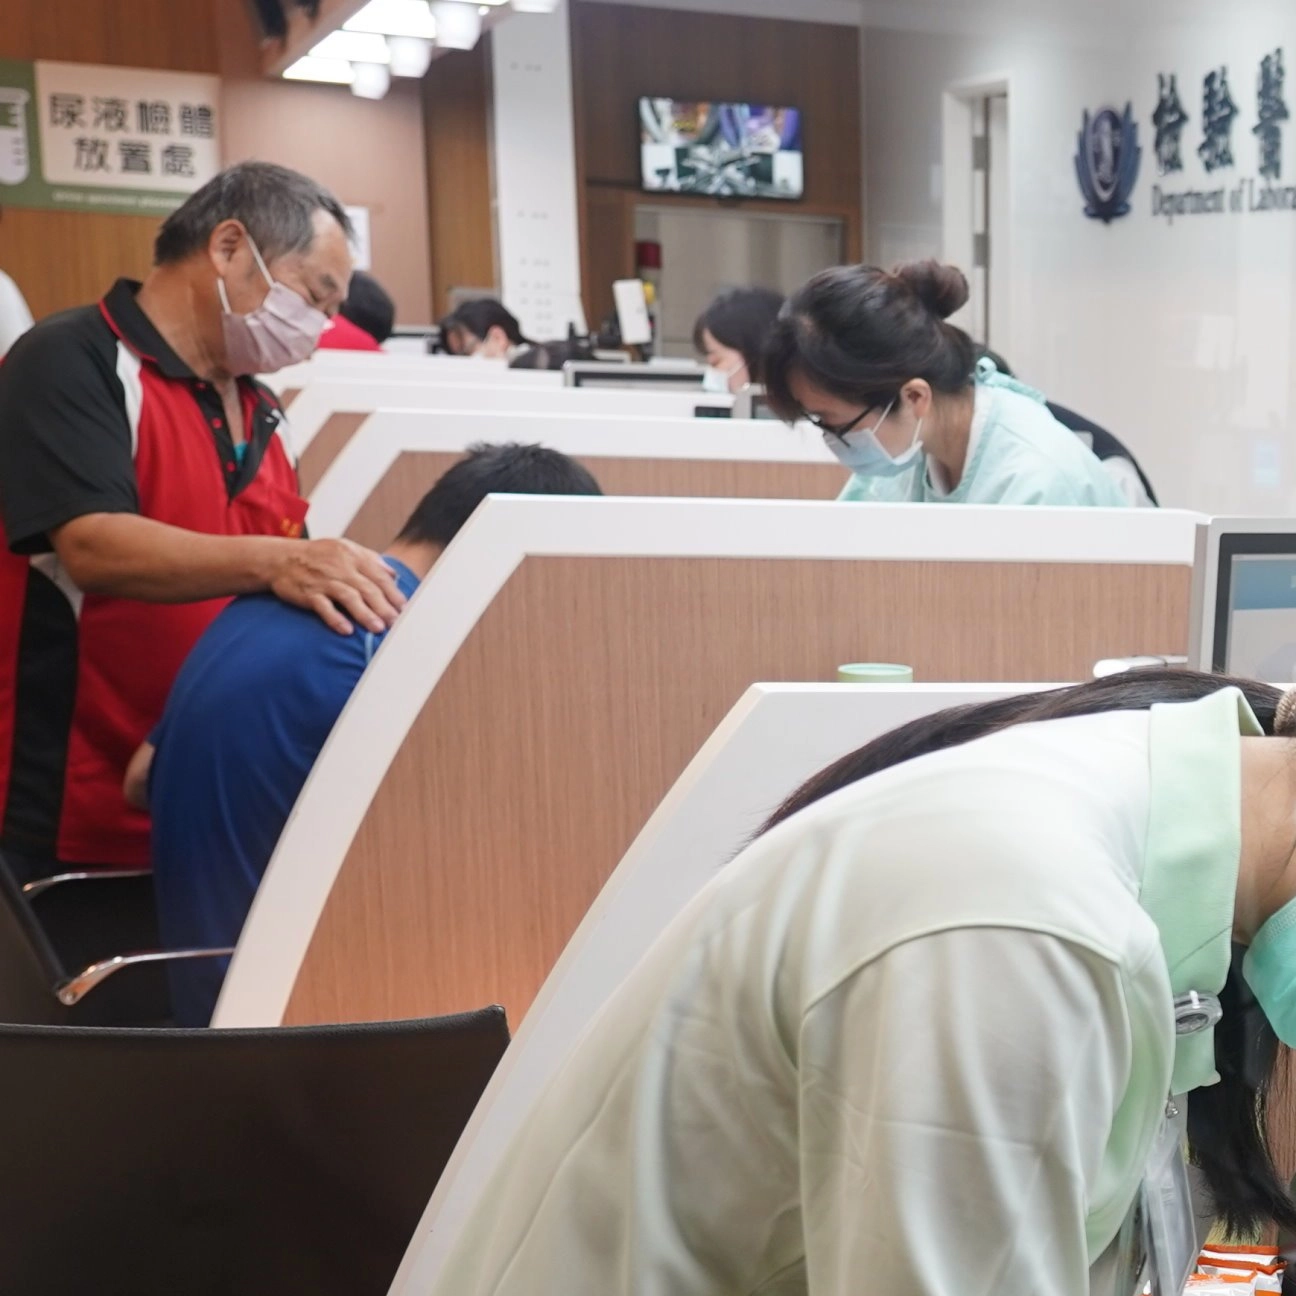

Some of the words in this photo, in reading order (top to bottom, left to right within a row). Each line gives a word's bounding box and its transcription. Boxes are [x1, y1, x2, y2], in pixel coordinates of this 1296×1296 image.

[48, 92, 215, 140] 尿液檢體
[73, 136, 197, 179] 放置處
[1151, 183, 1225, 225] Department
[1229, 179, 1246, 213] of
